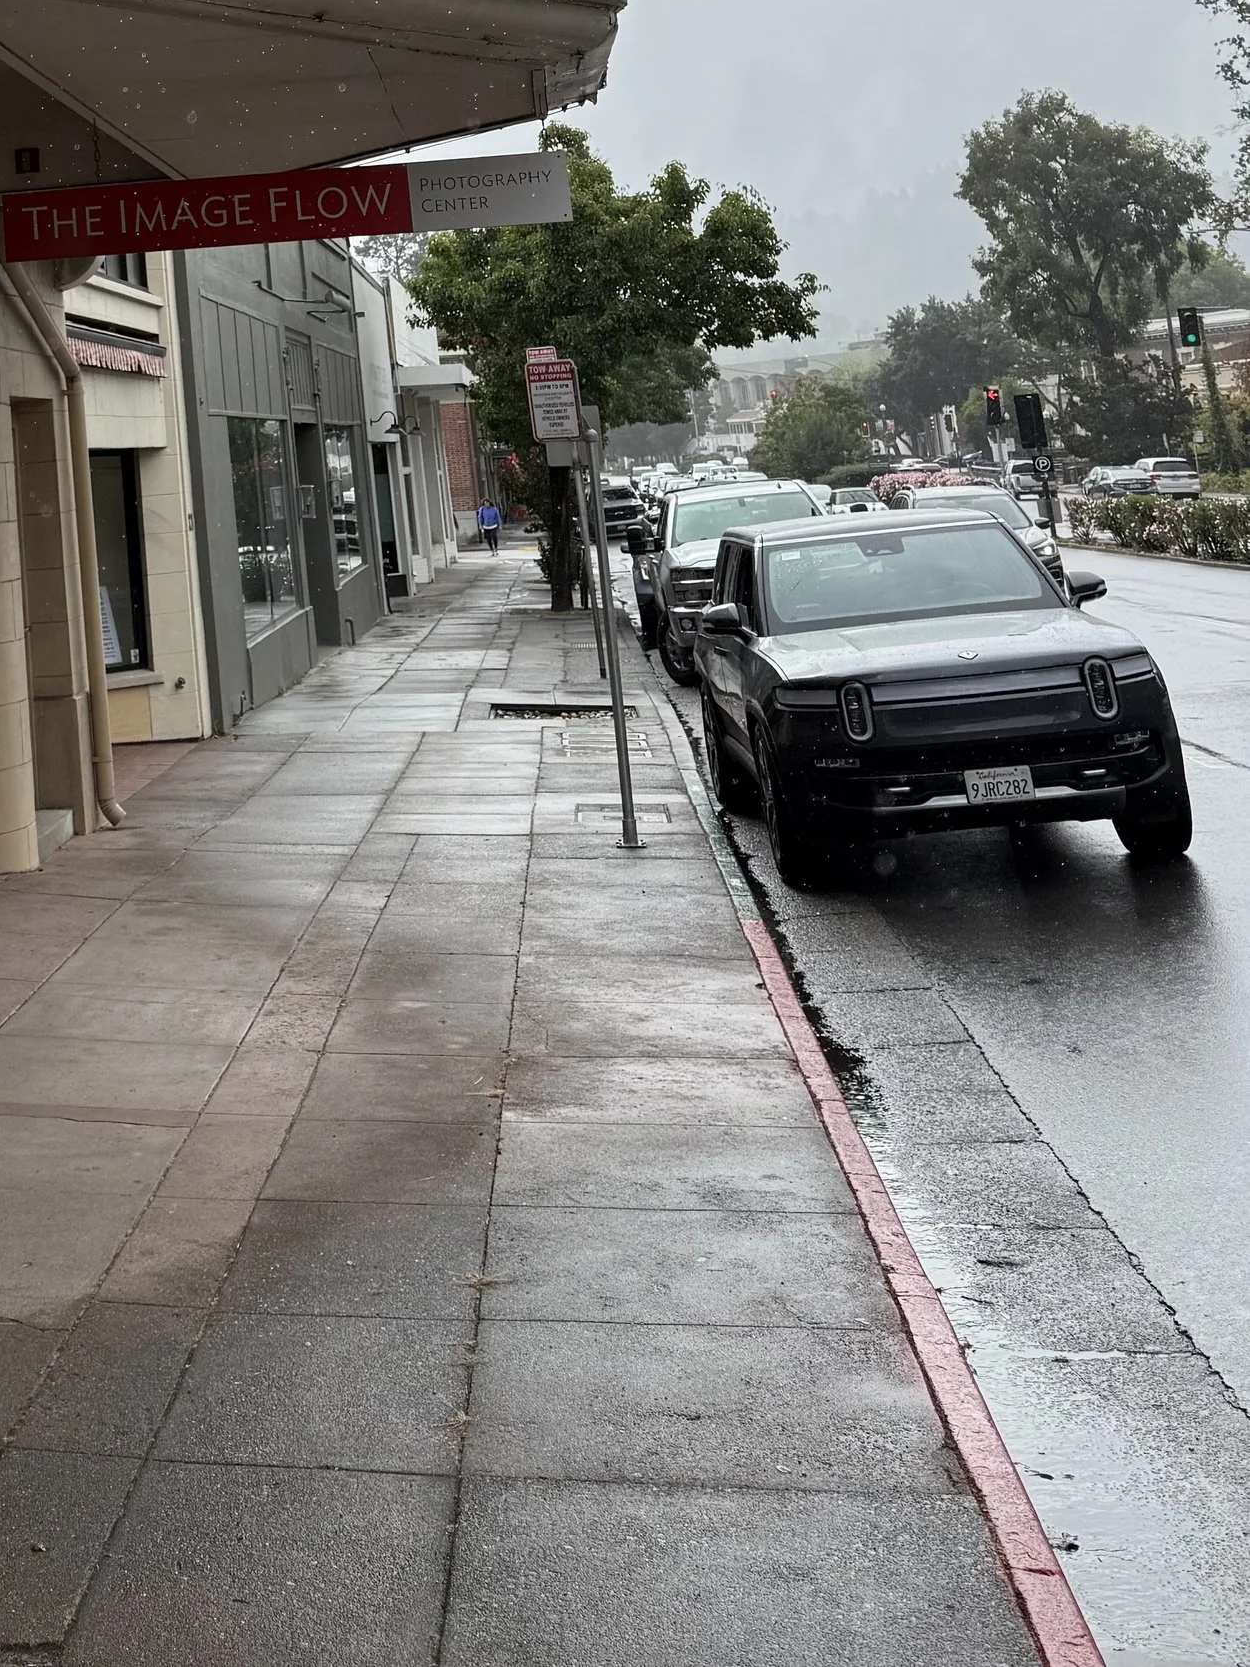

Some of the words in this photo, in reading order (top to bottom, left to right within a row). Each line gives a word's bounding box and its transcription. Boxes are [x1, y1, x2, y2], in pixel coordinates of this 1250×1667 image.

[419, 169, 553, 192] PHOTOGRAPHY
[21, 204, 105, 241] THE
[119, 192, 252, 234] IMAGE
[268, 181, 392, 224] FLOW
[420, 196, 490, 215] CENTER
[528, 365, 546, 374] TOW
[548, 363, 571, 373] AWAY
[540, 373, 572, 381] STOPPING
[979, 771, 1015, 781] California
[972, 779, 1030, 798] 9JRC282
